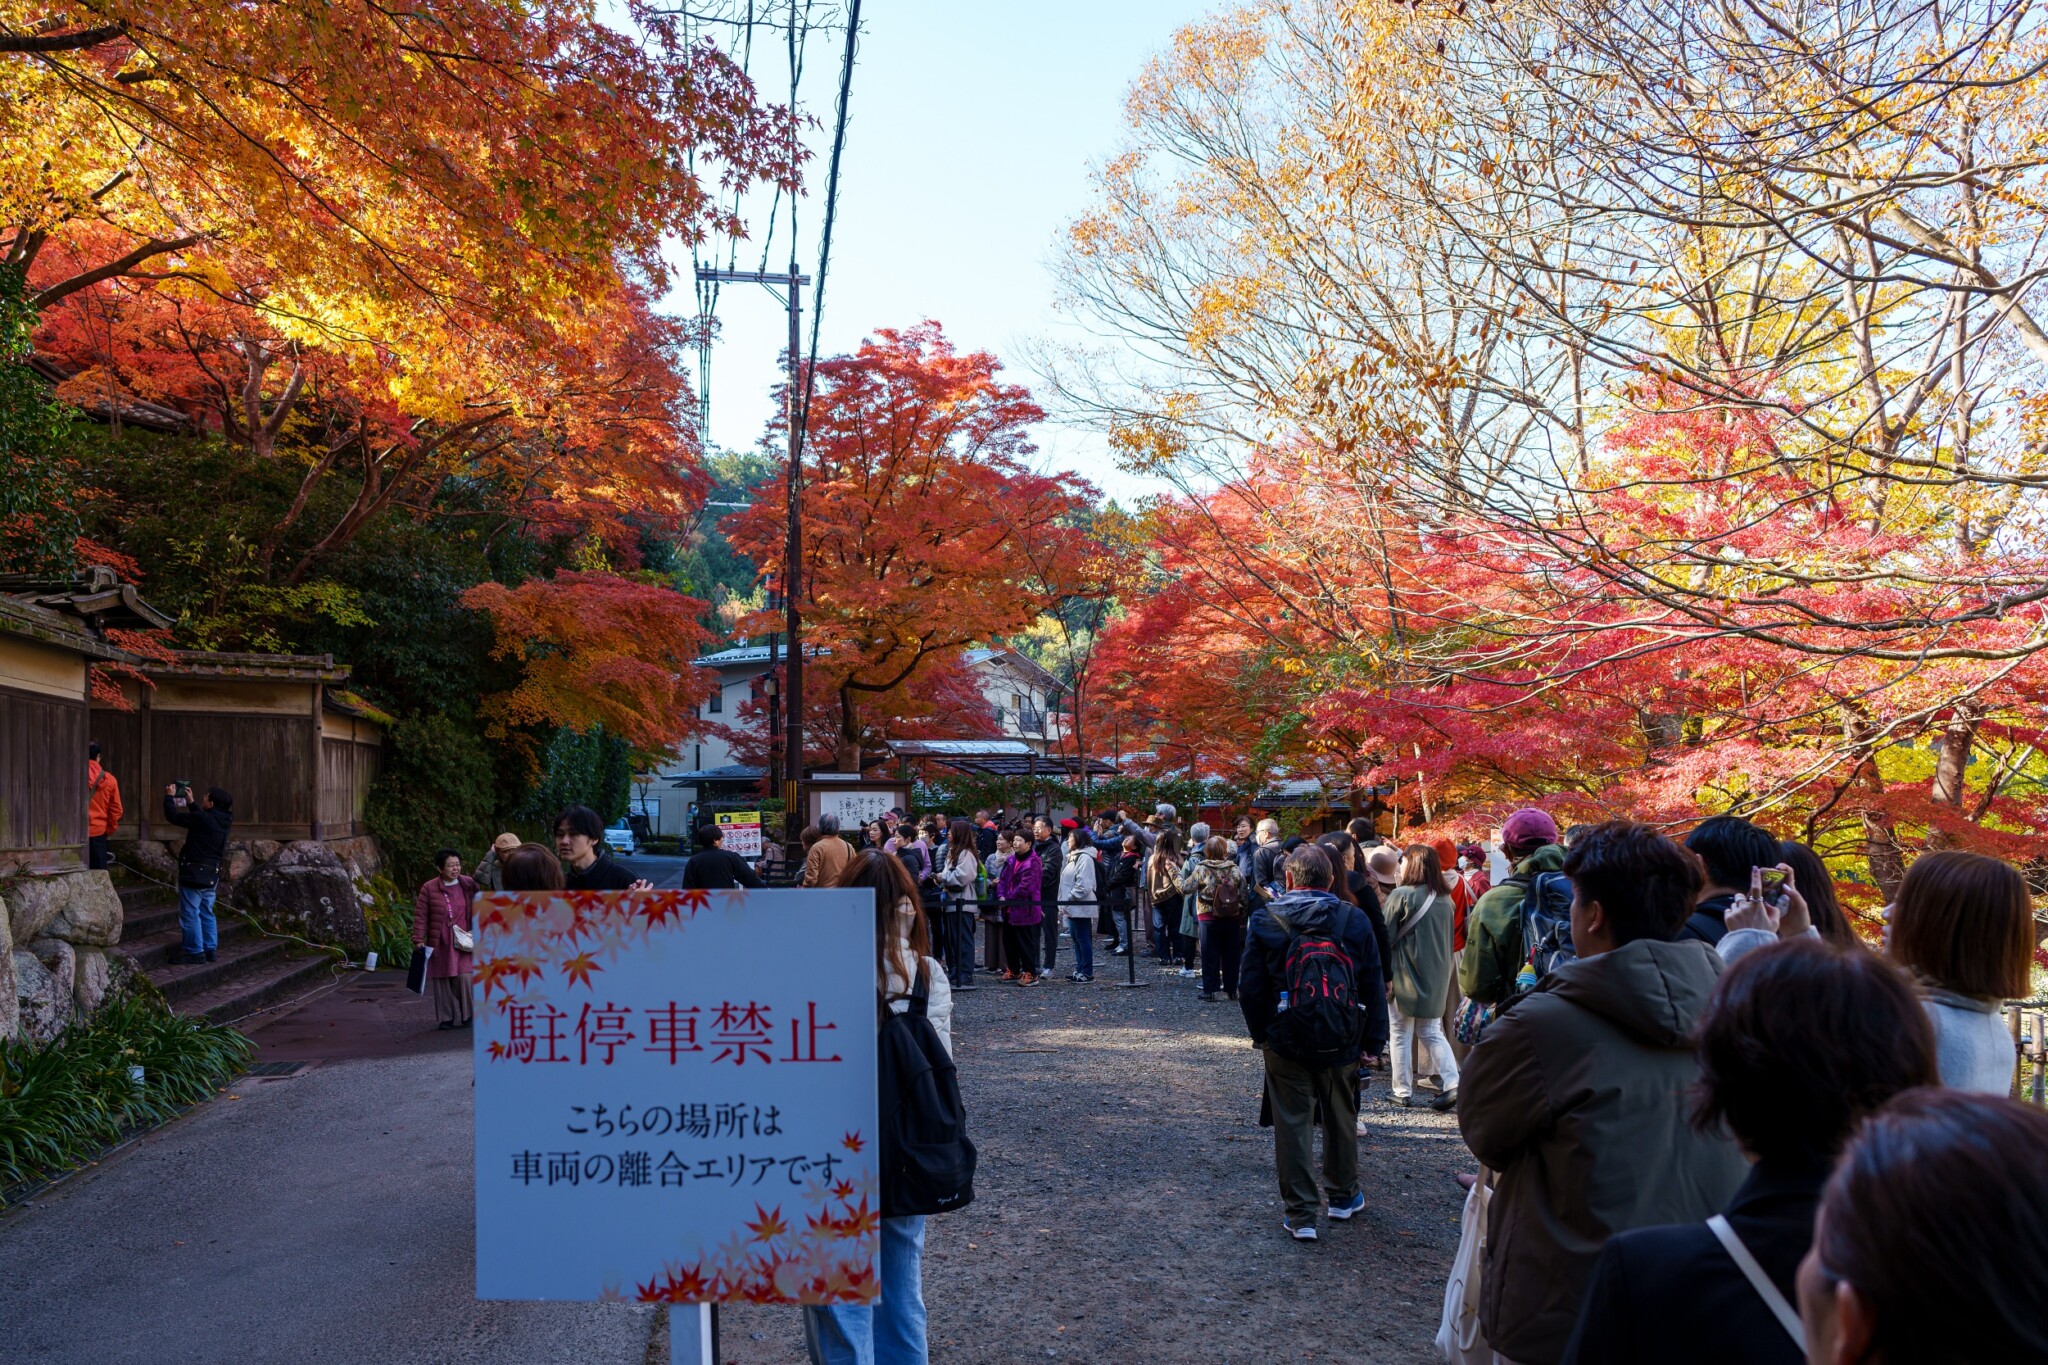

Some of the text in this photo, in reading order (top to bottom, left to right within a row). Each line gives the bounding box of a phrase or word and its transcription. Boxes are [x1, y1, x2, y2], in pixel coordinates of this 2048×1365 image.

[506, 1001, 843, 1066] 駐停車禁止
[566, 1103, 784, 1139] こちらの場所は
[511, 1150, 844, 1187] 車両の離合エリアです
